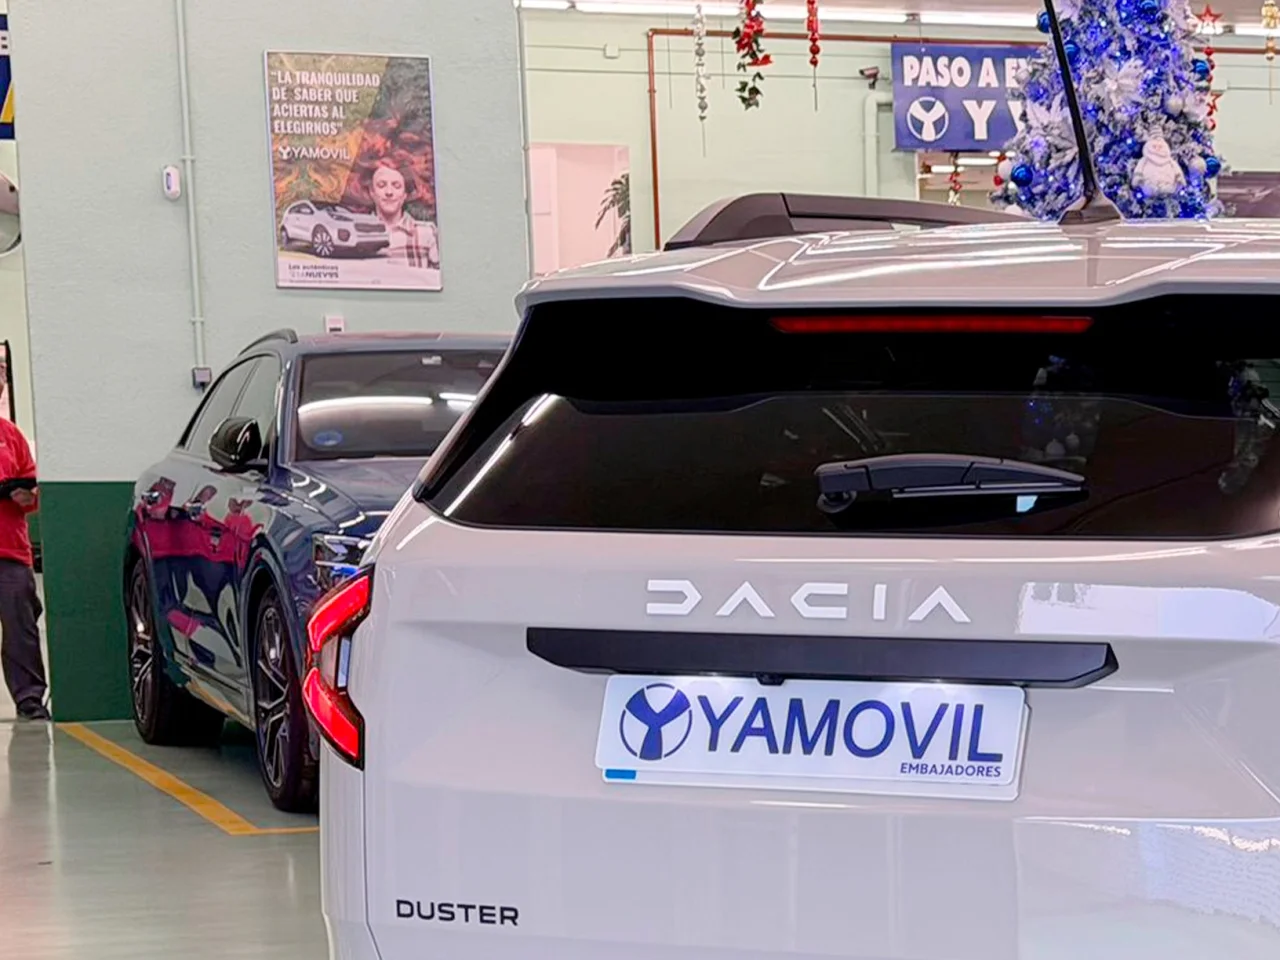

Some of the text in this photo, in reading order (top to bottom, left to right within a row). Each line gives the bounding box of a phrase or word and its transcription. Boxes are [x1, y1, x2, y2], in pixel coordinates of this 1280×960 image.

[296, 71, 380, 87] TRANQUILIDAD
[902, 55, 972, 88] PASO
[977, 57, 999, 88] A
[272, 87, 359, 103] DE SABER QUE
[273, 103, 346, 119] ACIERTAS AL
[962, 100, 996, 140] Y
[291, 146, 350, 159] YAMOVIL
[646, 578, 971, 623] DACIA
[696, 694, 1003, 763] YAMOVIL
[899, 761, 1002, 779] EMBAJADORES
[396, 899, 519, 926] DUSTER
